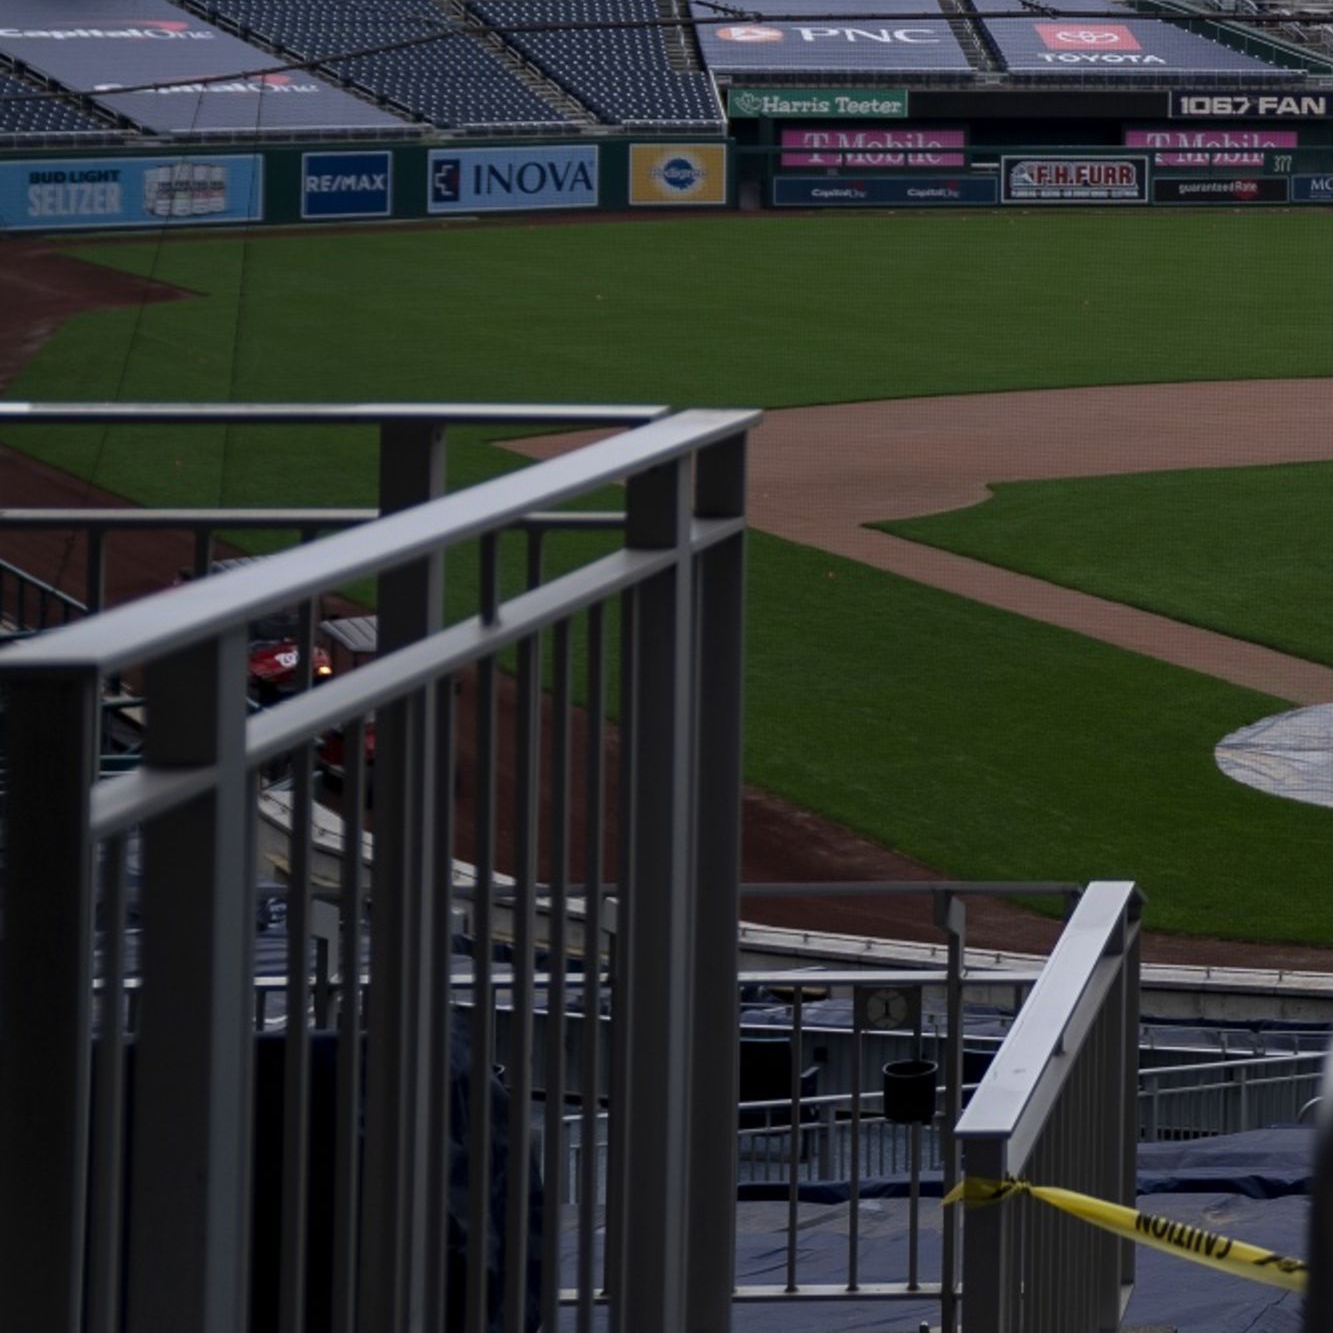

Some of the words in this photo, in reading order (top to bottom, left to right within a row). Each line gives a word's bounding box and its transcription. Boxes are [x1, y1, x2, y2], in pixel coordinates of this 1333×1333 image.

[795, 26, 940, 44] PNC
[1037, 52, 1165, 64] TOYOTA
[761, 96, 830, 114] Harris
[834, 96, 902, 114] Teeter
[1258, 96, 1327, 115] FAN
[1273, 154, 1292, 173] 377
[29, 171, 65, 184] BUD
[69, 170, 120, 183] LIGHT
[305, 173, 387, 194] RE/MAX
[473, 161, 594, 194] INOVA
[27, 183, 123, 217] SELTZER
[882, 1000, 891, 1018] 1
[1135, 1212, 1232, 1260] CAUTION
